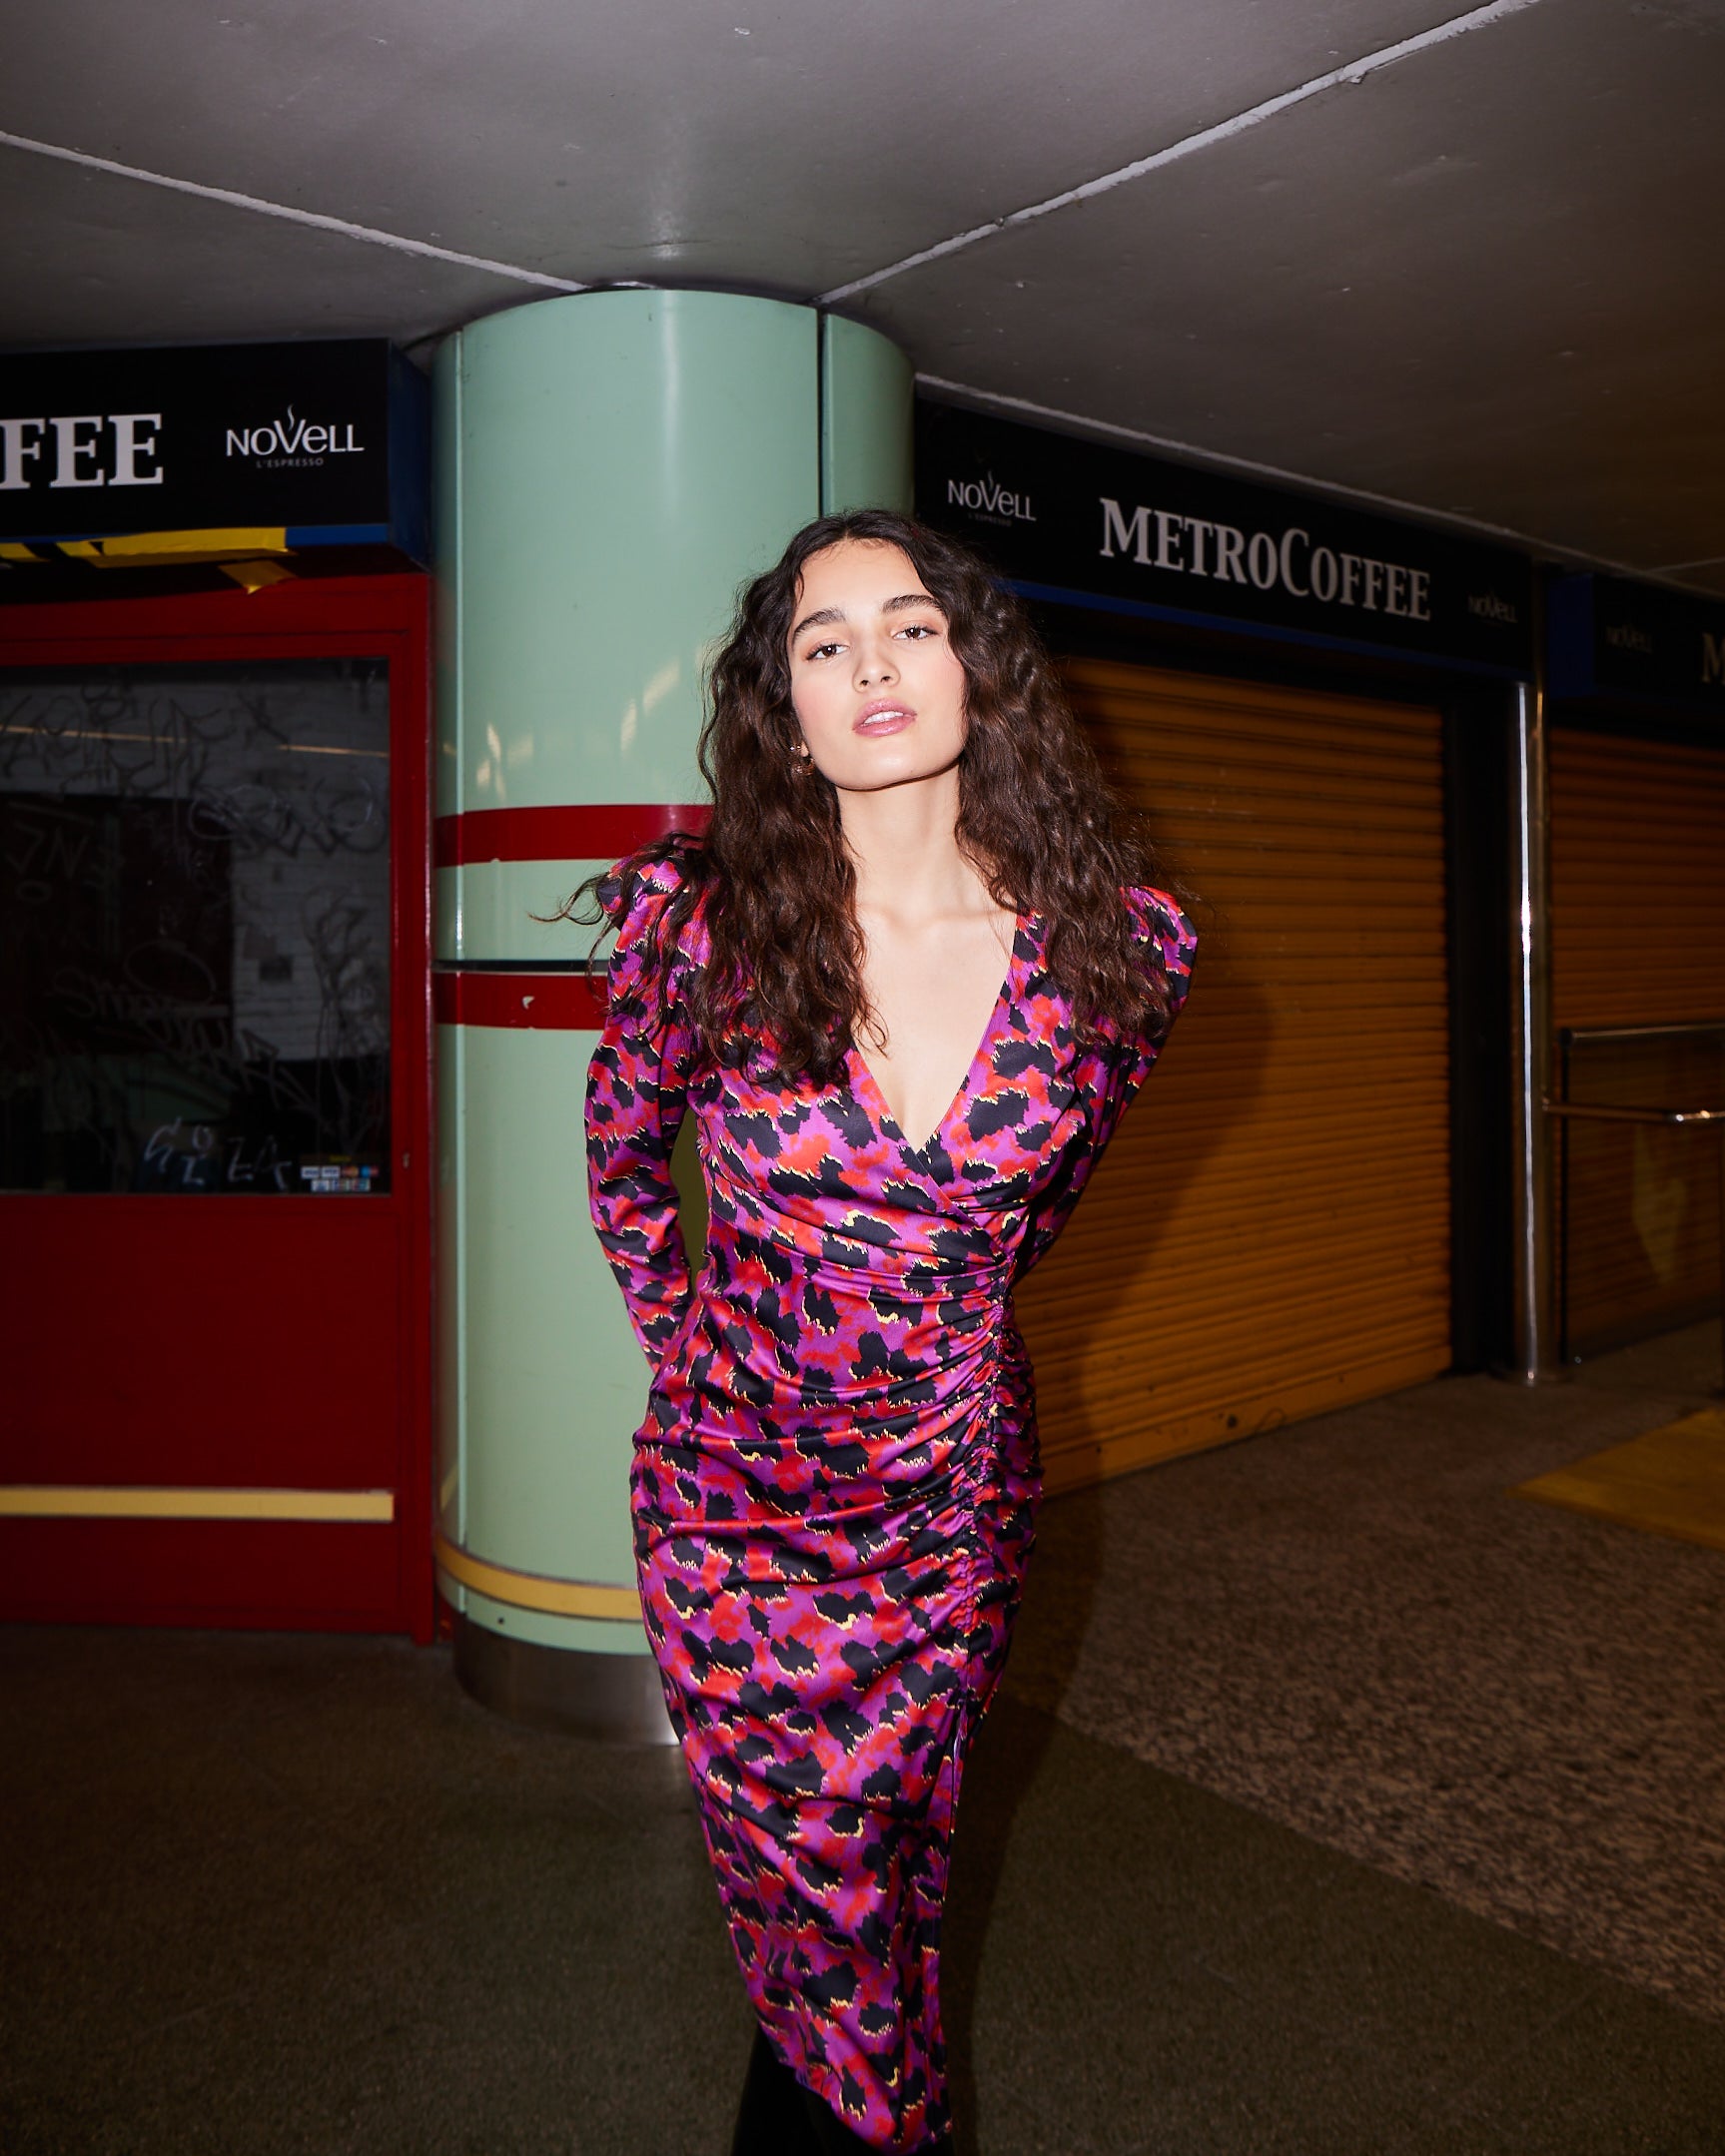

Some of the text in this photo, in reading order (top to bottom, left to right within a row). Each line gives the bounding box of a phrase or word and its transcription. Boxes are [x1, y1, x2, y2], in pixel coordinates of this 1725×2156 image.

[0, 413, 164, 490] FEE
[226, 418, 366, 457] NOVeLL
[948, 479, 1037, 521] NOVeLL
[1100, 497, 1431, 621] METROCOFFEE
